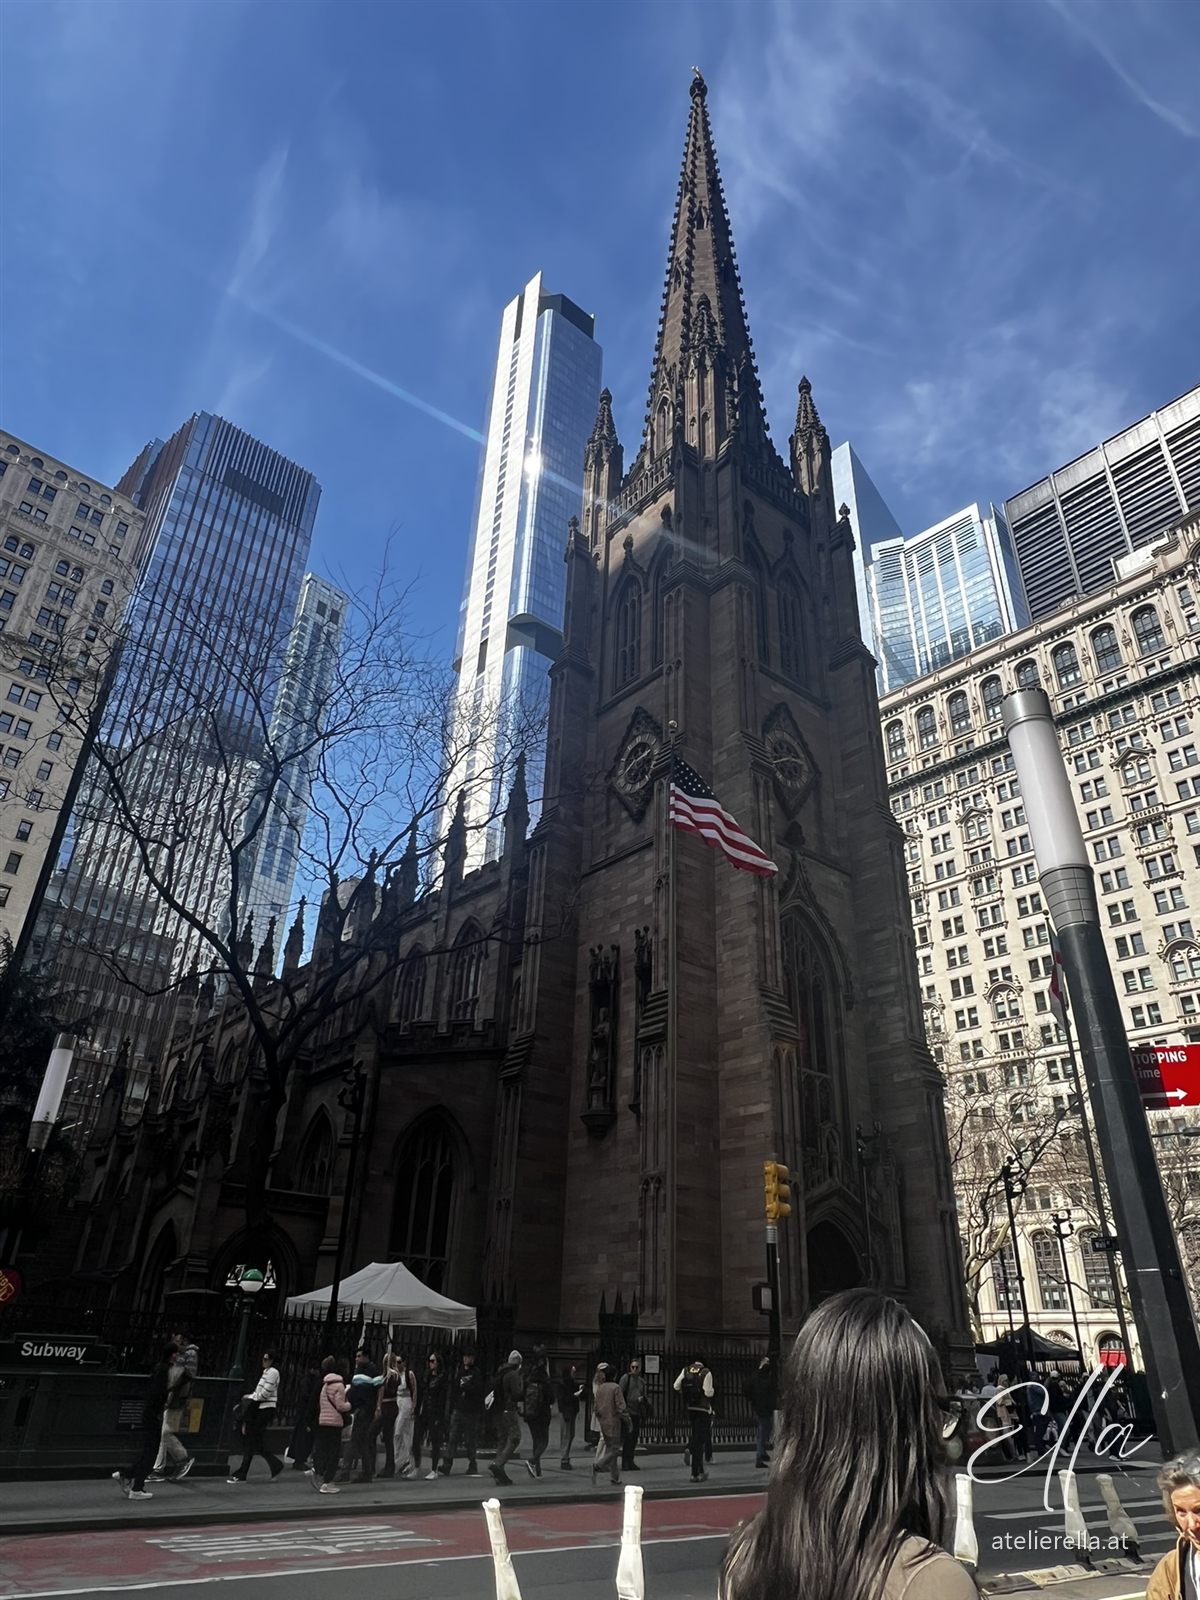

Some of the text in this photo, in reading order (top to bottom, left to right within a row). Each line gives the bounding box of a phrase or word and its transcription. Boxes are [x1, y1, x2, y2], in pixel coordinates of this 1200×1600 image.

[1134, 1050, 1187, 1064] TOPPING
[1138, 1067, 1160, 1078] ime
[21, 1341, 87, 1360] Subway
